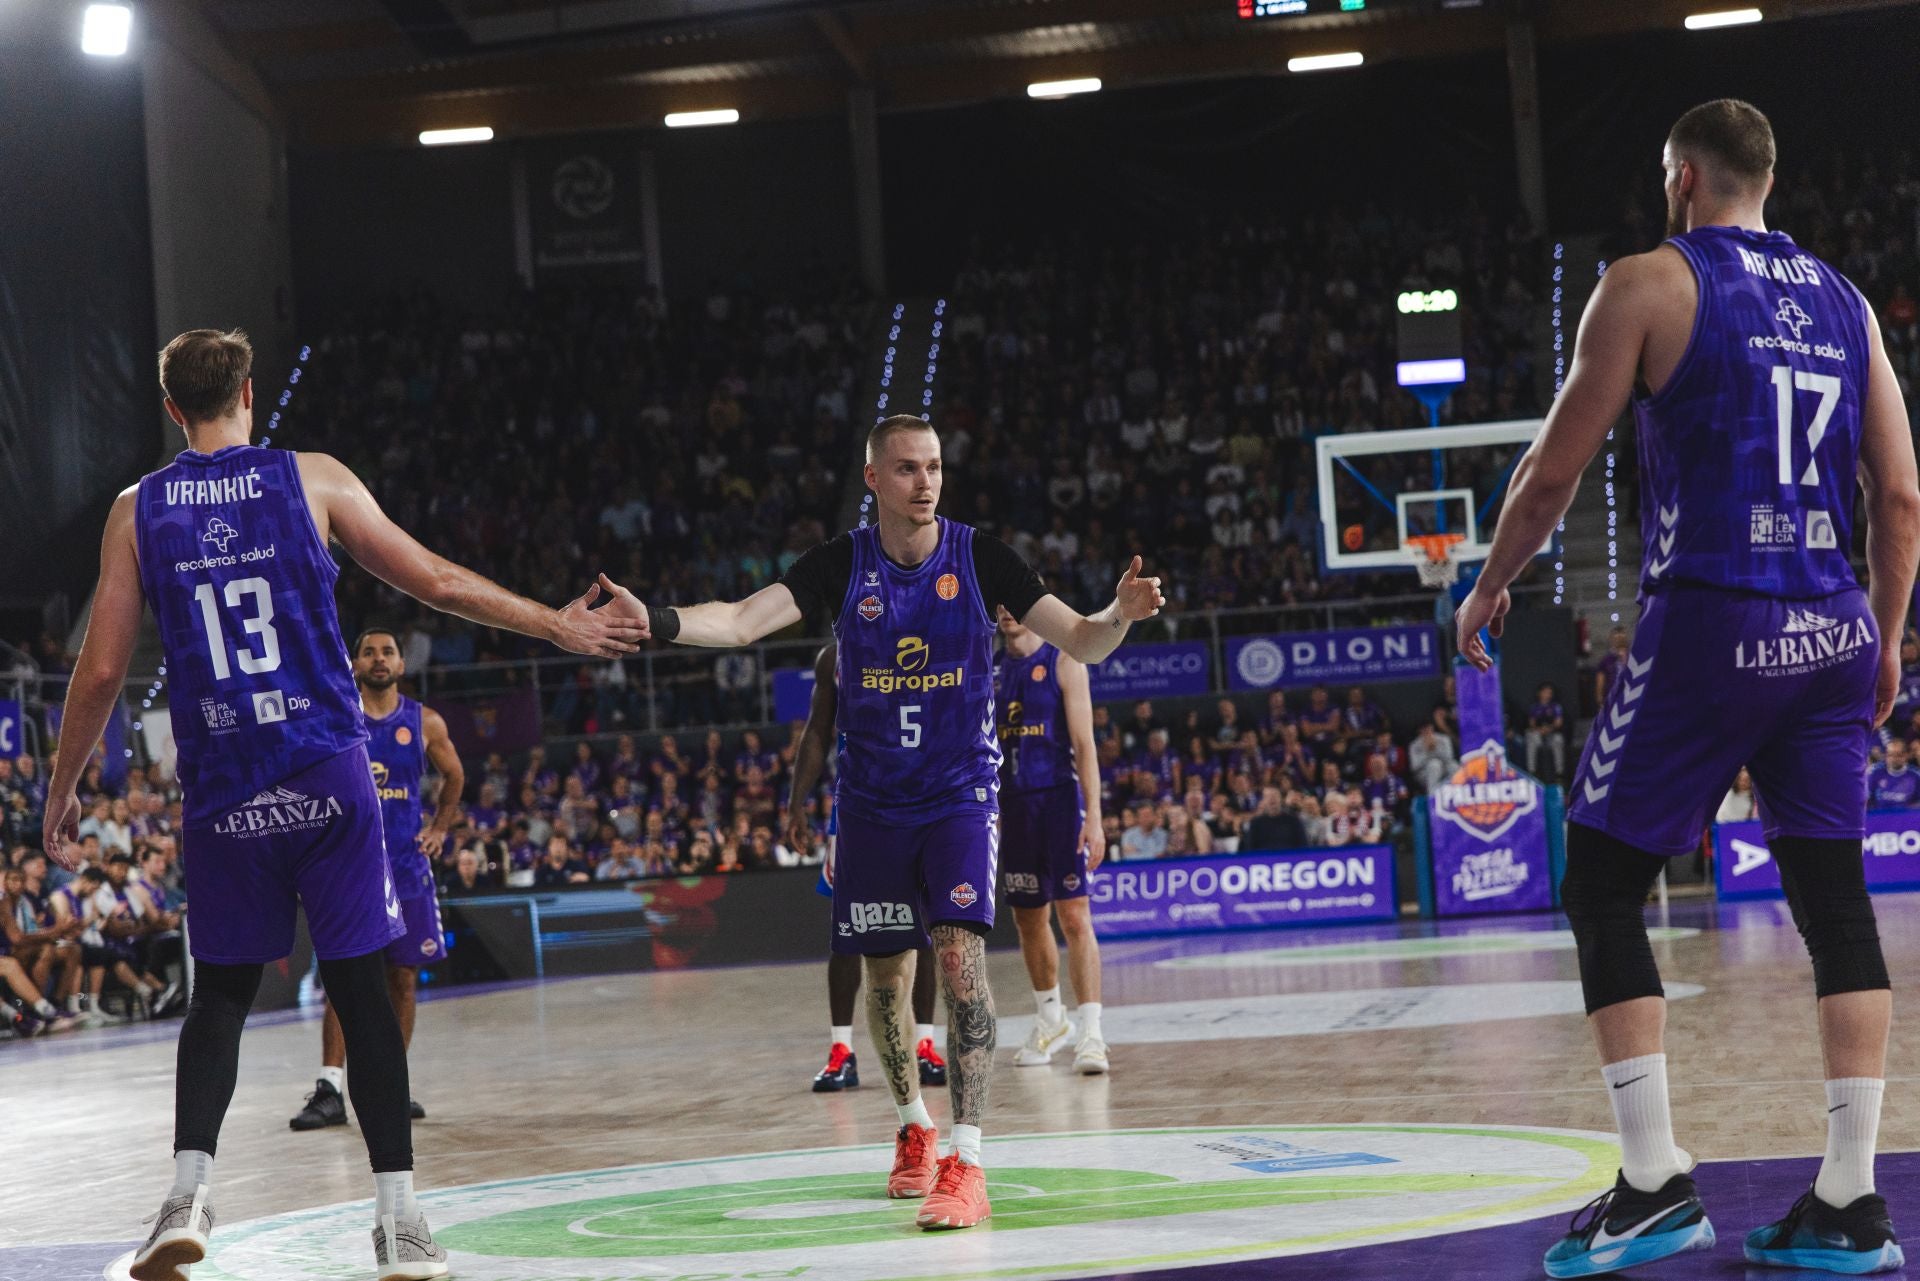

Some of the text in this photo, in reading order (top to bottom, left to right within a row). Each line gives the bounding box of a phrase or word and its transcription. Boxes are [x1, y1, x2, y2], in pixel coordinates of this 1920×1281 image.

[1814, 342, 1846, 361] salud
[1770, 365, 1842, 487] 17
[165, 466, 263, 506] VRANKIĆ
[1775, 513, 1790, 523] PA
[1775, 523, 1796, 533] LEN
[1775, 533, 1795, 543] CIA
[175, 544, 275, 573] recoletas salud
[194, 576, 282, 681] 13
[1735, 616, 1875, 669] LEBANZA
[1292, 632, 1431, 666] DIONI
[862, 667, 894, 676] súper
[862, 667, 963, 694] agropal
[288, 696, 312, 711] Dip
[900, 705, 922, 748] 5
[214, 796, 343, 834] LEBANZA
[850, 901, 915, 934] gaza
